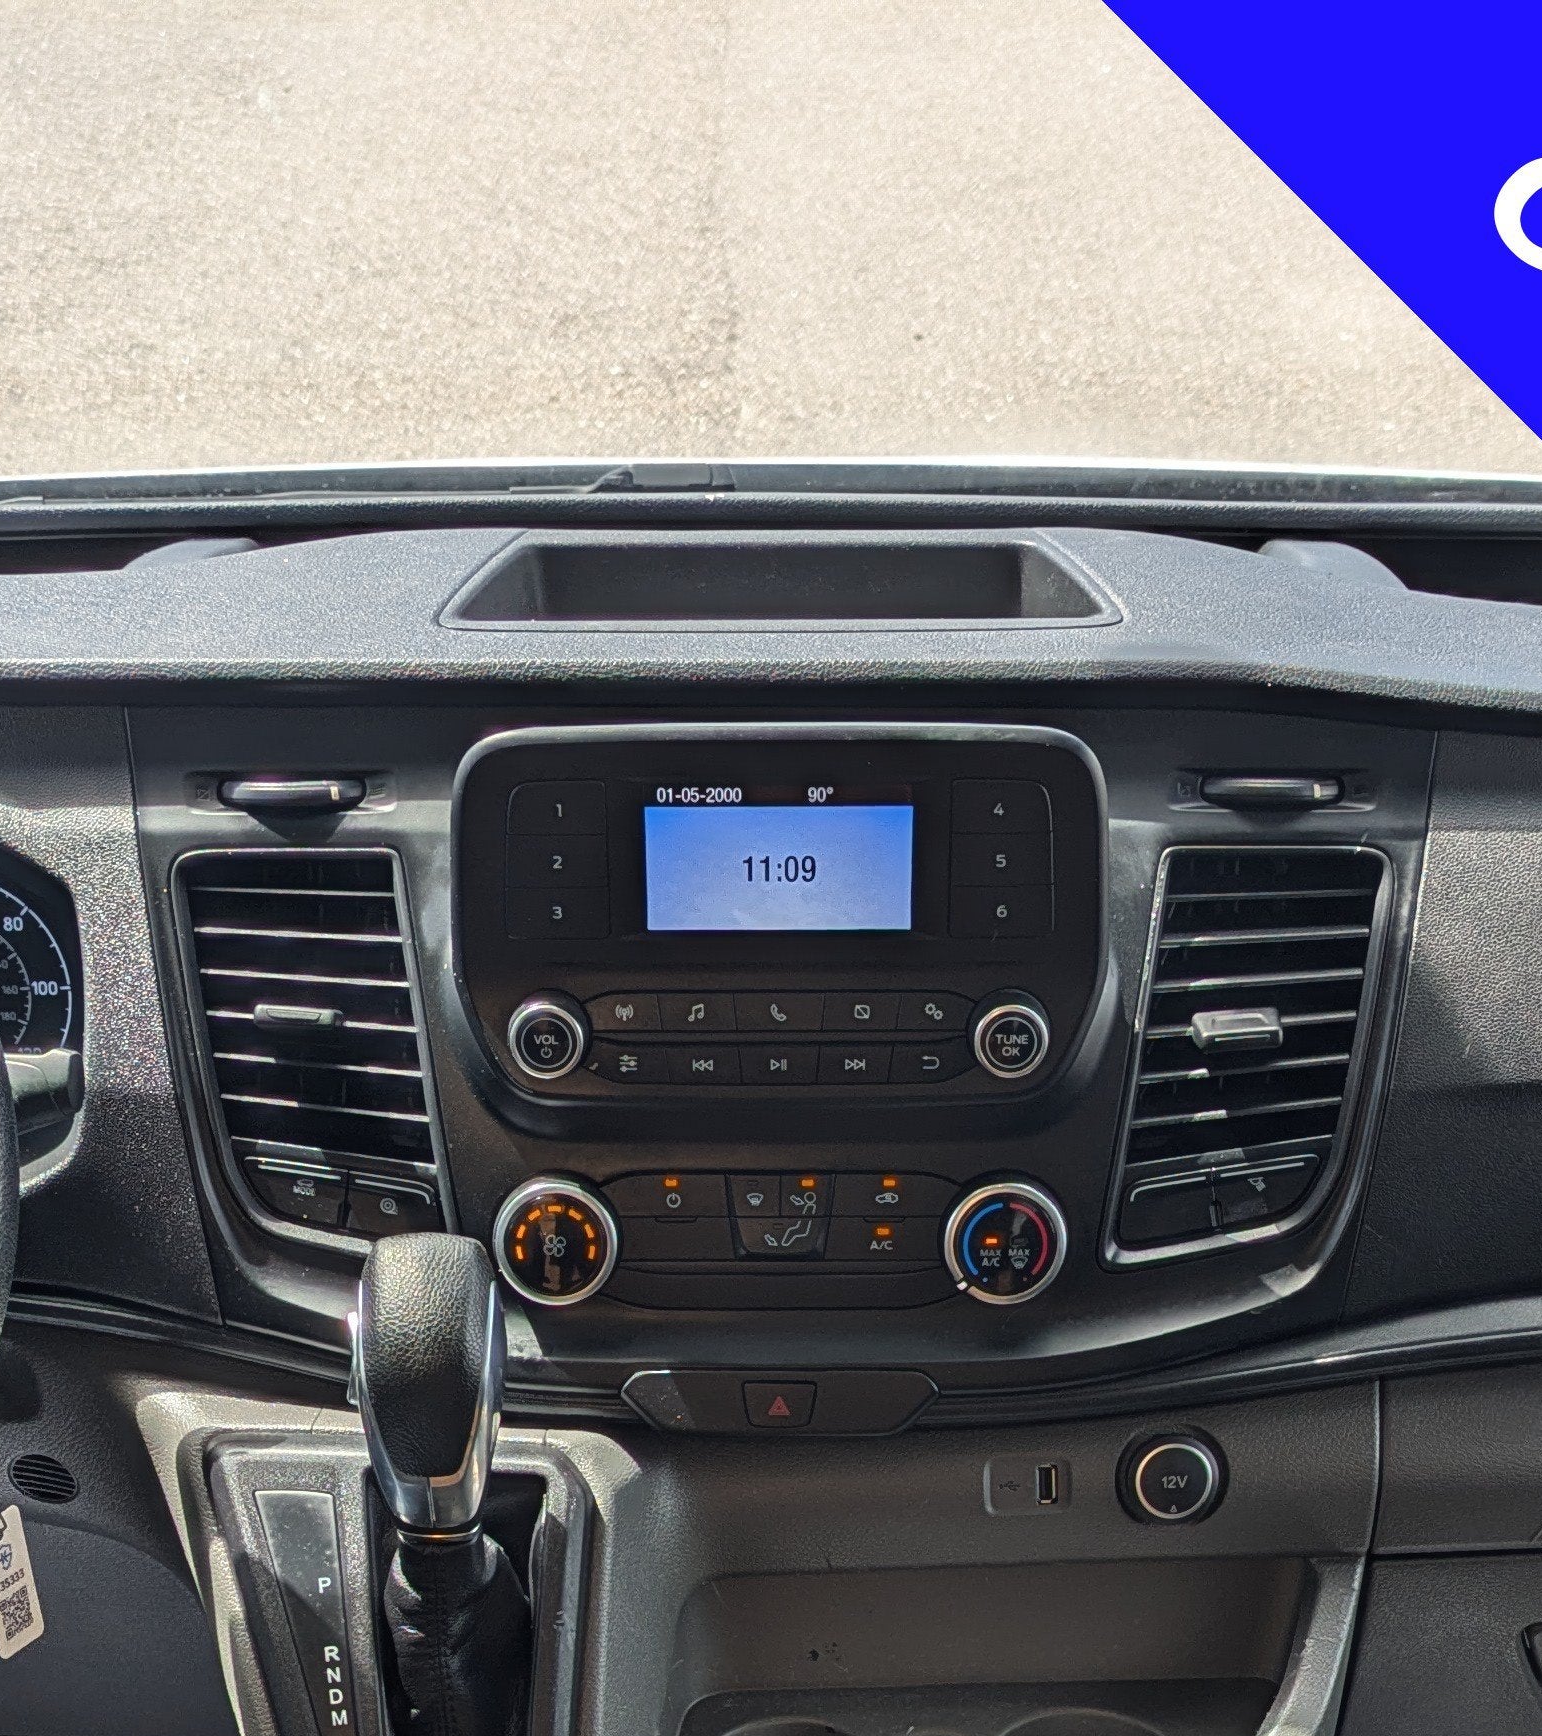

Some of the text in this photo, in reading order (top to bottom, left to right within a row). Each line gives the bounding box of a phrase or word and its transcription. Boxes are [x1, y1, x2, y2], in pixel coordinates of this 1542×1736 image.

[656, 786, 834, 803] 01-05-2000 90°
[556, 804, 563, 818] 1
[993, 803, 1005, 816] 4
[552, 856, 563, 869] 2
[995, 854, 1007, 868] 5
[742, 856, 817, 882] 11:09
[552, 906, 563, 920] 3
[996, 905, 1008, 918] 6
[3, 917, 24, 931] 80
[31, 981, 58, 996] 100
[533, 1034, 559, 1045] VOL
[995, 1034, 1029, 1045] TUNE
[1002, 1046, 1020, 1057] OK
[869, 1240, 894, 1250] A/C
[979, 1249, 1001, 1257] MAX
[1009, 1248, 1031, 1257] MAX
[981, 1257, 1001, 1267] A/C
[1161, 1475, 1189, 1489] 12V
[318, 1577, 331, 1594] P
[324, 1645, 340, 1662] R
[326, 1666, 341, 1683] N
[328, 1688, 343, 1705] D
[331, 1709, 348, 1726] M
